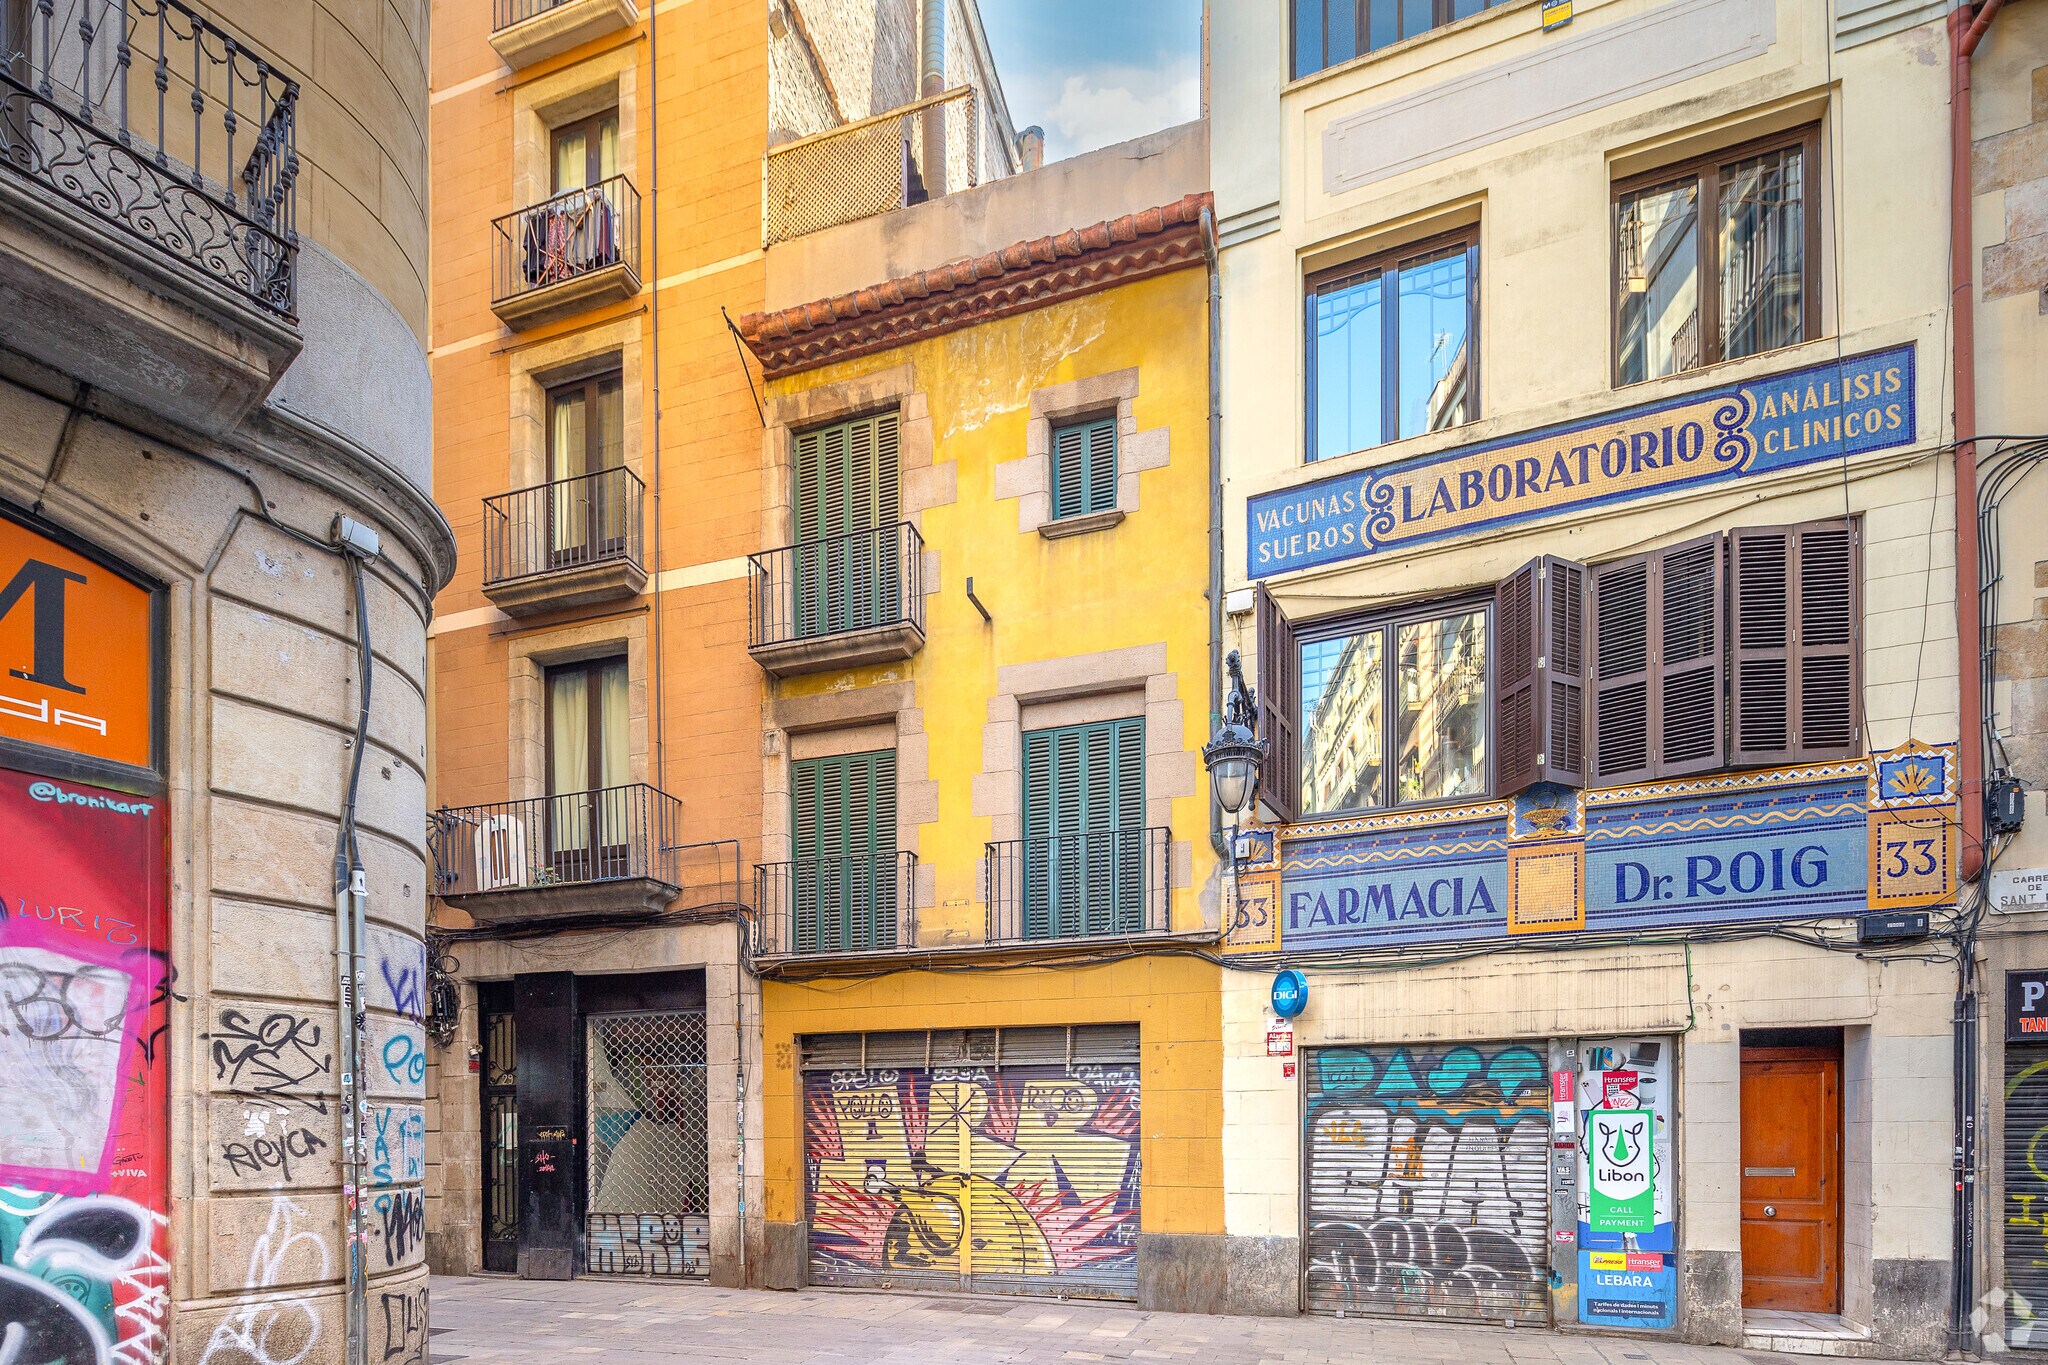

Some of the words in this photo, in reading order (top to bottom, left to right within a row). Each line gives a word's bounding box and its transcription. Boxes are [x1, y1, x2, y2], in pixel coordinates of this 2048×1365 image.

[1761, 367, 1902, 420] ANÁLISIS
[1763, 403, 1902, 454] CLÍNICOS
[1401, 421, 1705, 524] LABORATORIO
[1256, 490, 1356, 533] VACUNAS
[1258, 522, 1356, 563] SUEROS
[1886, 838, 1937, 878] 33
[1614, 861, 1673, 904] Dr.
[1685, 844, 1830, 898] ROIG
[2027, 883, 2043, 892] DE
[1237, 897, 1269, 929] 33
[1289, 875, 1498, 929] FARMACIA
[2000, 894, 2037, 905] SANT
[1273, 990, 1298, 1001] DIGI
[2021, 981, 2048, 1012] P
[502, 1073, 514, 1085] 29
[1598, 1168, 1645, 1182] Libon
[1599, 1219, 1645, 1227] PAYMENT
[1609, 1206, 1634, 1214] CALL
[1596, 1274, 1653, 1288] LEBARA
